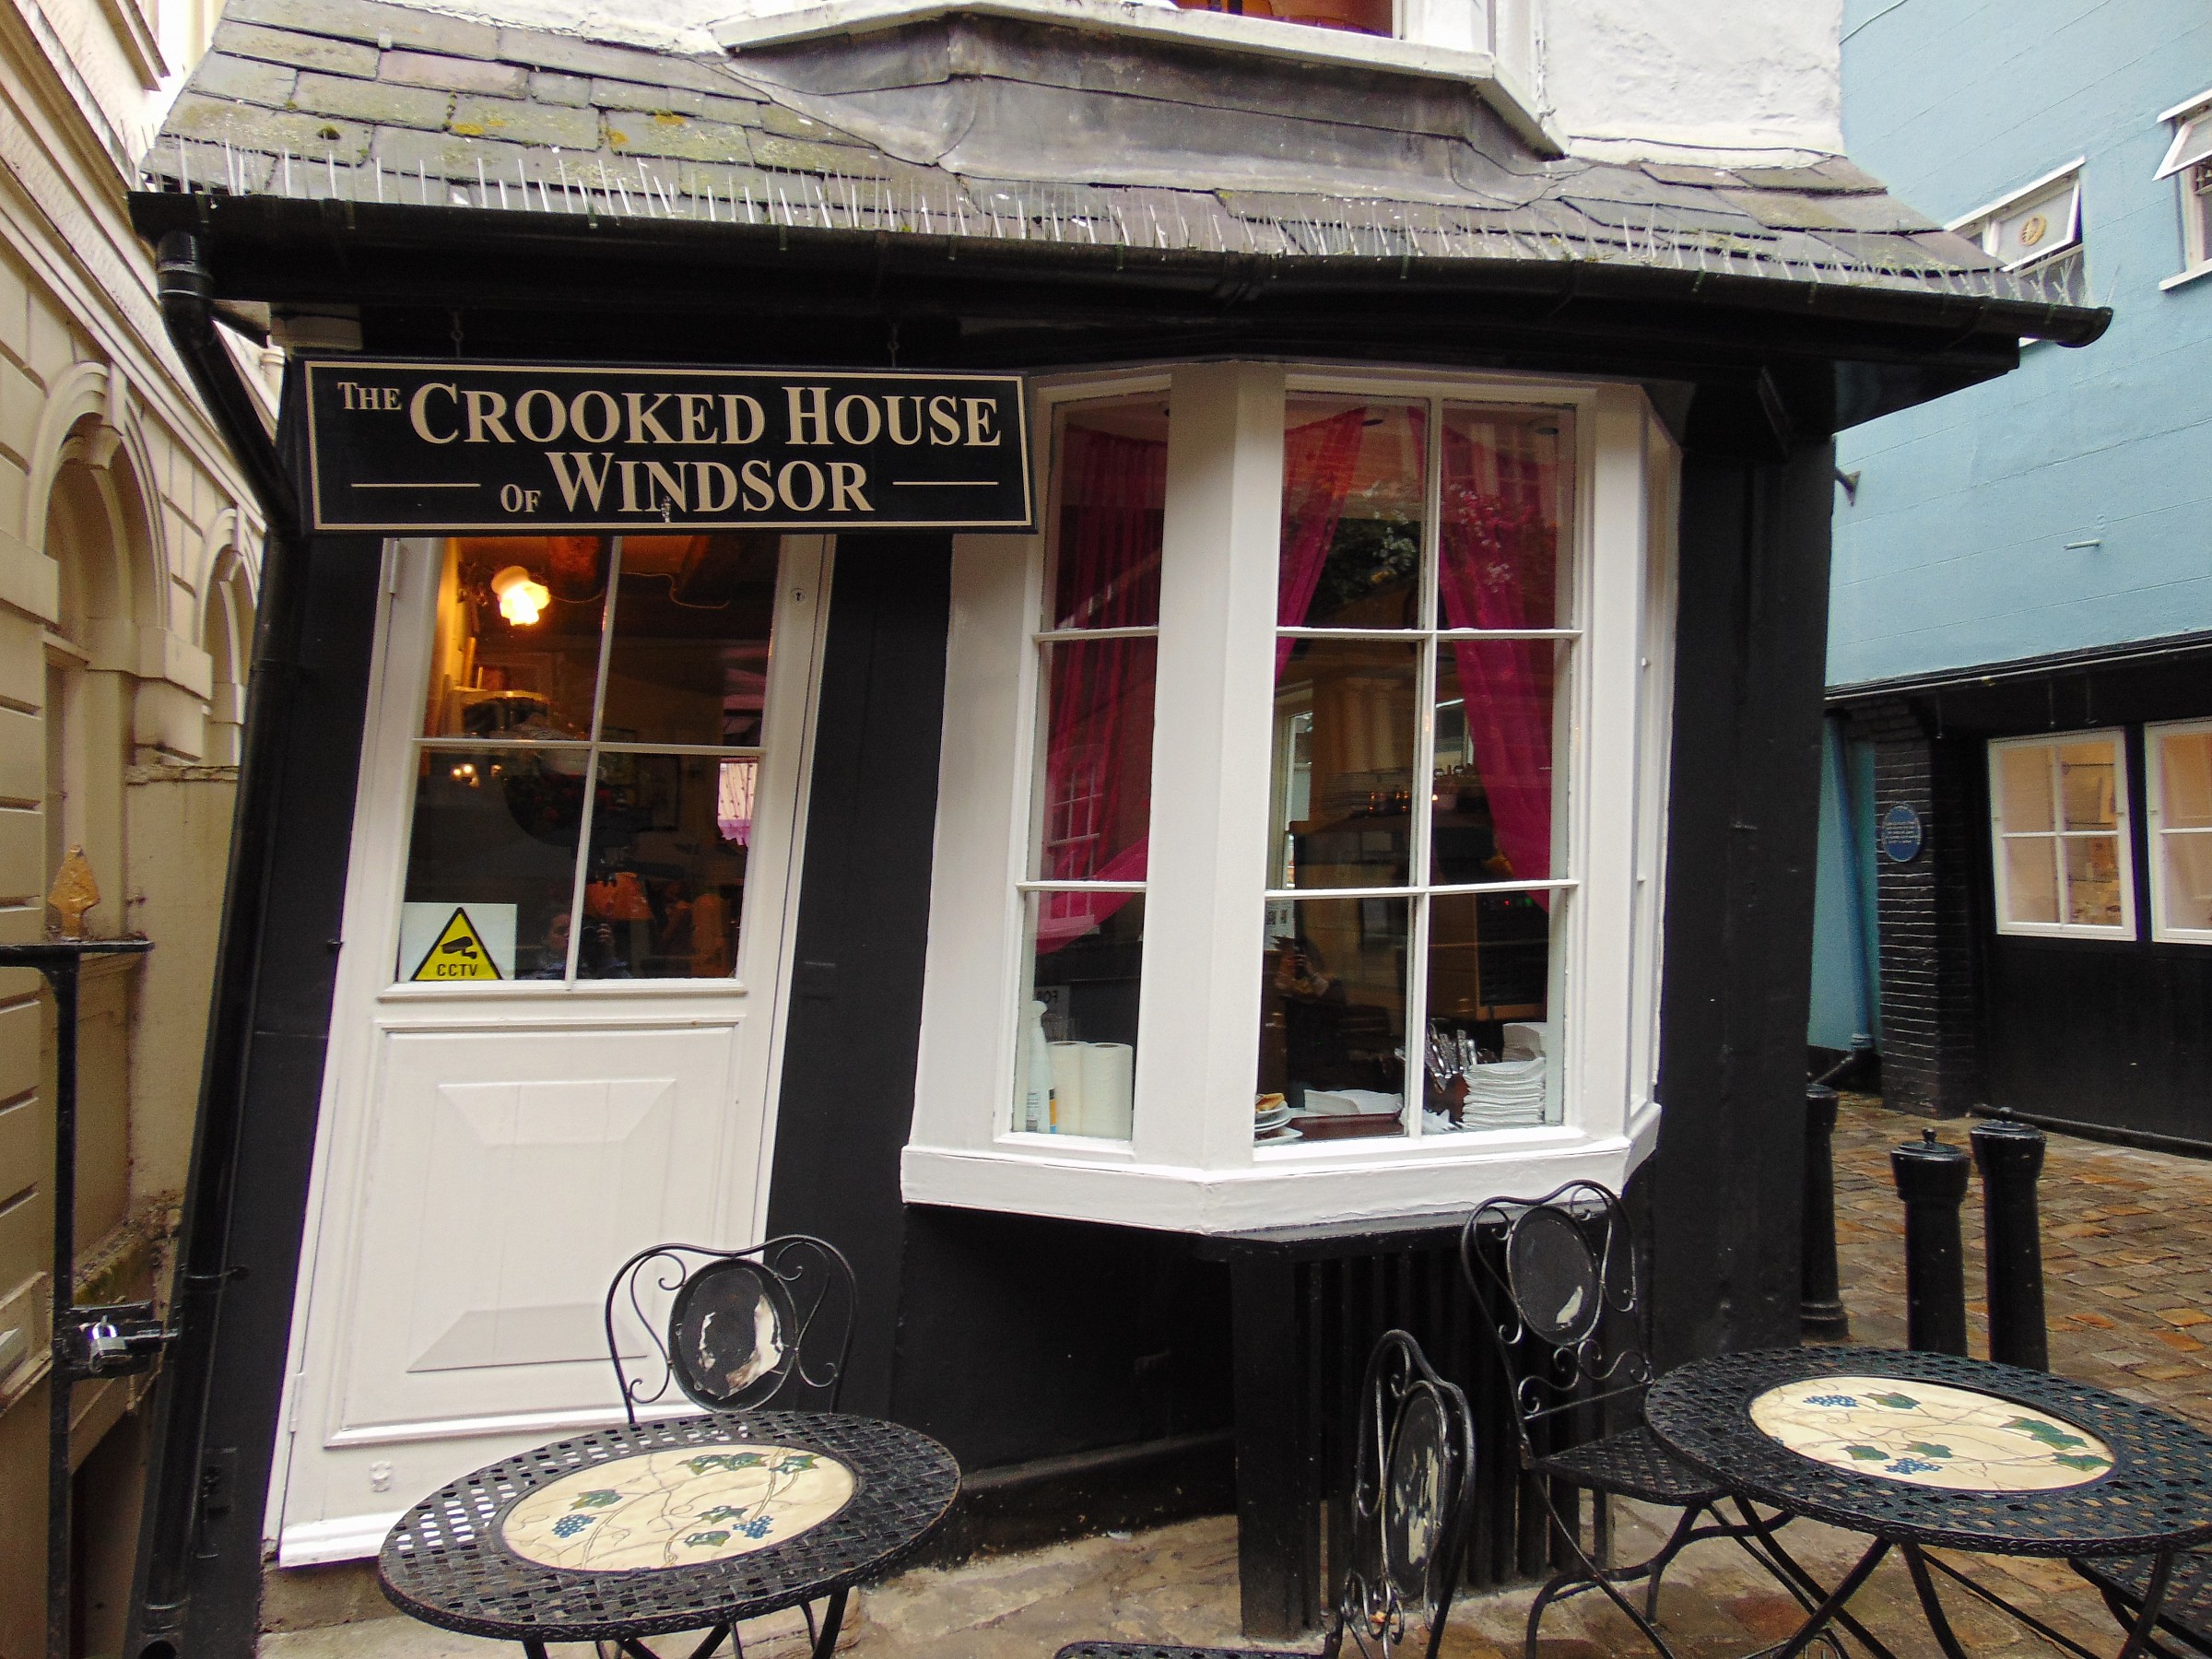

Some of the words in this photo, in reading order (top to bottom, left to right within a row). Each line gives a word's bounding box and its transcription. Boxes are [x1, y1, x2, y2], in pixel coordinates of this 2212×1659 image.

[337, 382, 403, 410] THE
[409, 382, 765, 444] CROOKED
[781, 386, 1001, 446] HOUSE
[500, 483, 541, 512] OF
[544, 452, 875, 512] WINDSOR
[437, 963, 478, 977] CCTV
